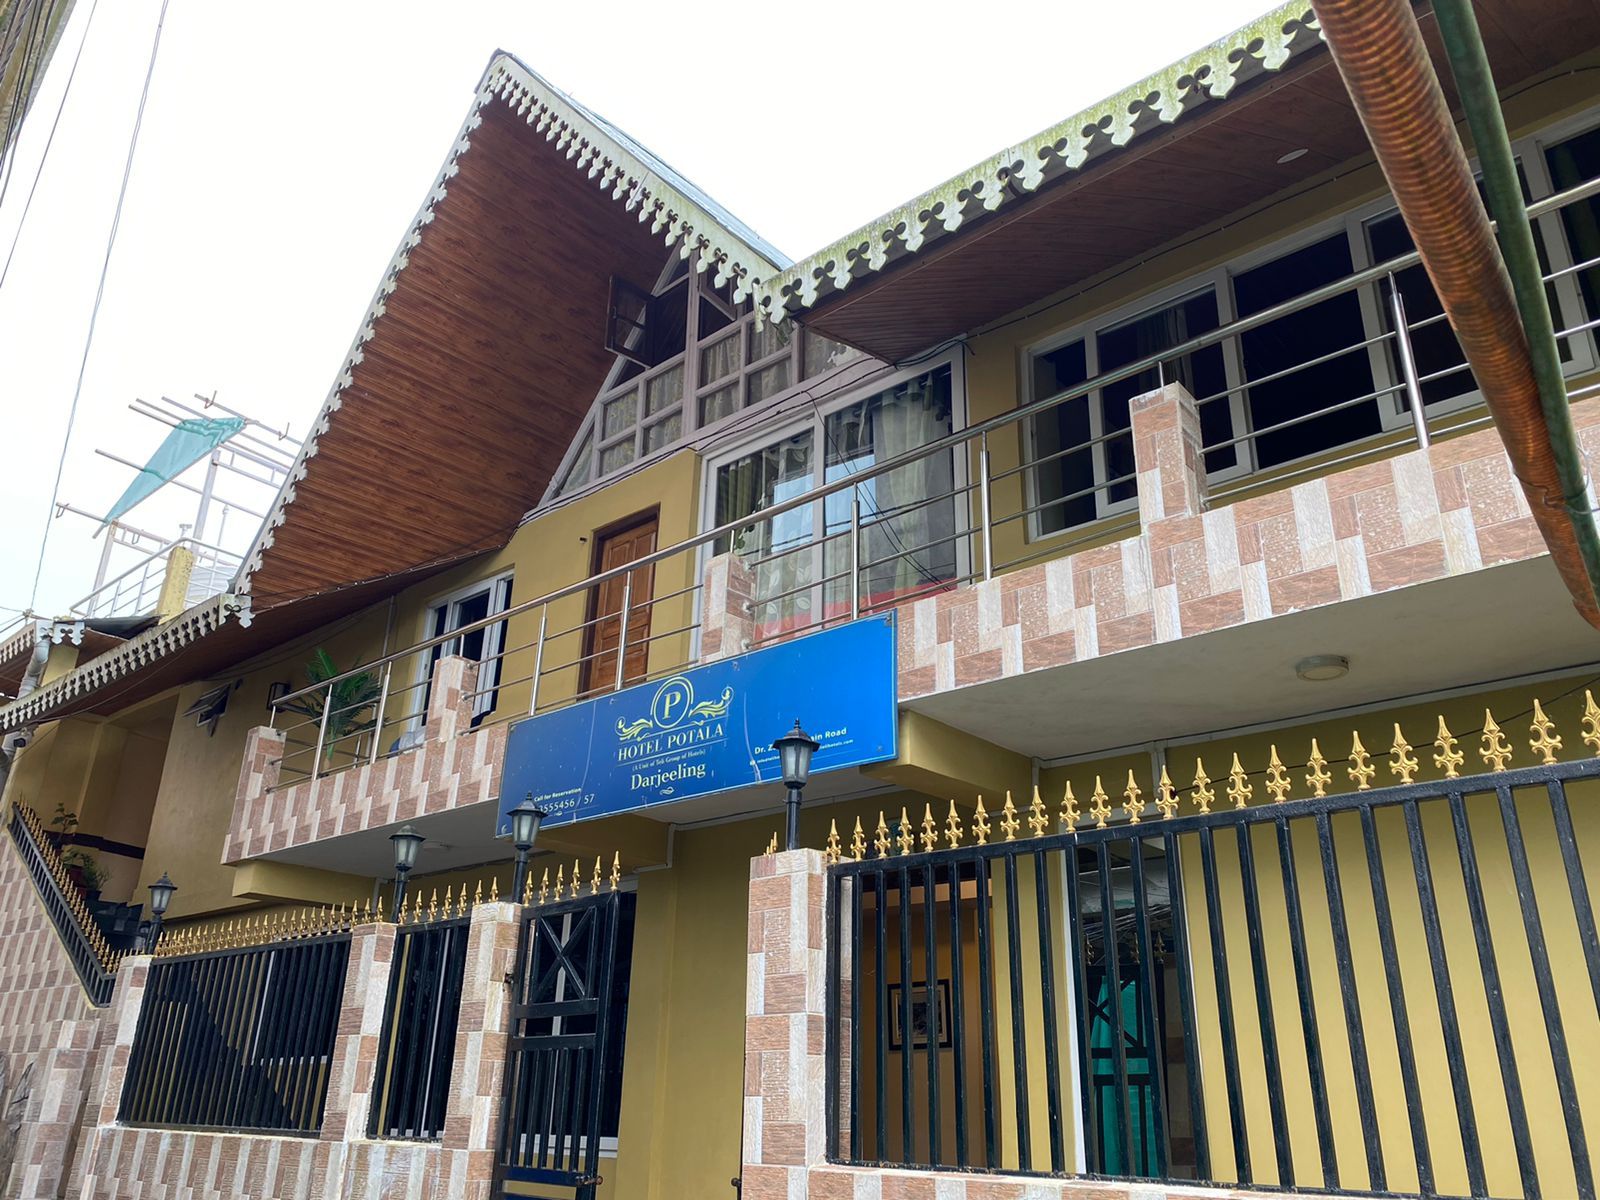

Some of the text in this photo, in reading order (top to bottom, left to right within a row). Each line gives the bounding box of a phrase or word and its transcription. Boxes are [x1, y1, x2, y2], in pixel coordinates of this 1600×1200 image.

[662, 691, 681, 719] P
[618, 723, 724, 761] HOTEL POTALA
[754, 746, 766, 755] Dr.
[825, 727, 847, 739] Road
[631, 763, 706, 790] Darjeeling
[552, 788, 582, 798] Reservation
[584, 794, 595, 805] 57
